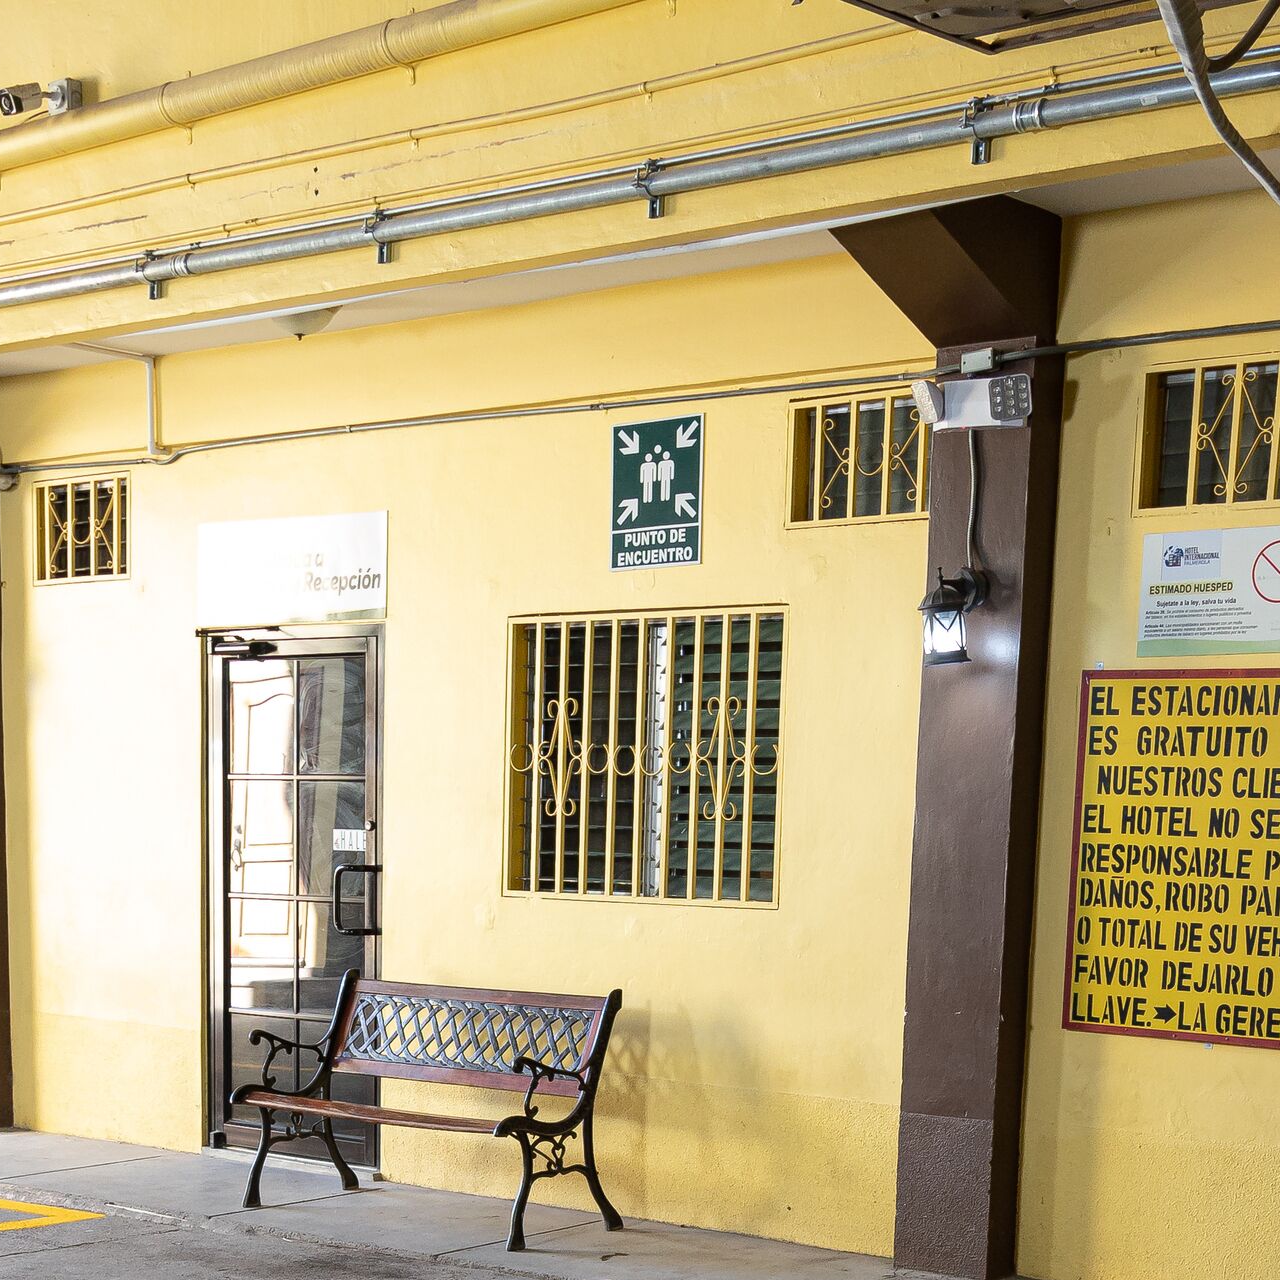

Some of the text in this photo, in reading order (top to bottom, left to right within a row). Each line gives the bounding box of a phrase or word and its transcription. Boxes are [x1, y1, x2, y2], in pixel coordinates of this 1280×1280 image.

[624, 528, 686, 548] PUNTO DE
[617, 546, 693, 566] ENCUENTRO
[1150, 582, 1233, 594] ESTIMADO HUESPED
[1090, 686, 1120, 717] EL
[1088, 725, 1119, 756] ES
[1137, 726, 1268, 757] GRATUITO
[1096, 766, 1223, 797] NUESTROS
[1083, 804, 1111, 835] EL
[1121, 806, 1198, 838] HOTEL
[1208, 807, 1239, 838] NO
[1080, 843, 1253, 880] RESPONSABLE
[1080, 876, 1161, 915] DAÑOS,
[1164, 883, 1229, 913] ROBO
[1076, 916, 1091, 946] O
[1099, 918, 1166, 951] TOTAL
[1174, 921, 1202, 953] DE
[1209, 923, 1237, 955] SU
[1074, 954, 1149, 988] FAVOR
[1161, 960, 1274, 997] DEJARLO
[1071, 992, 1152, 1028] LLAVE.
[1178, 1001, 1207, 1031] LA
